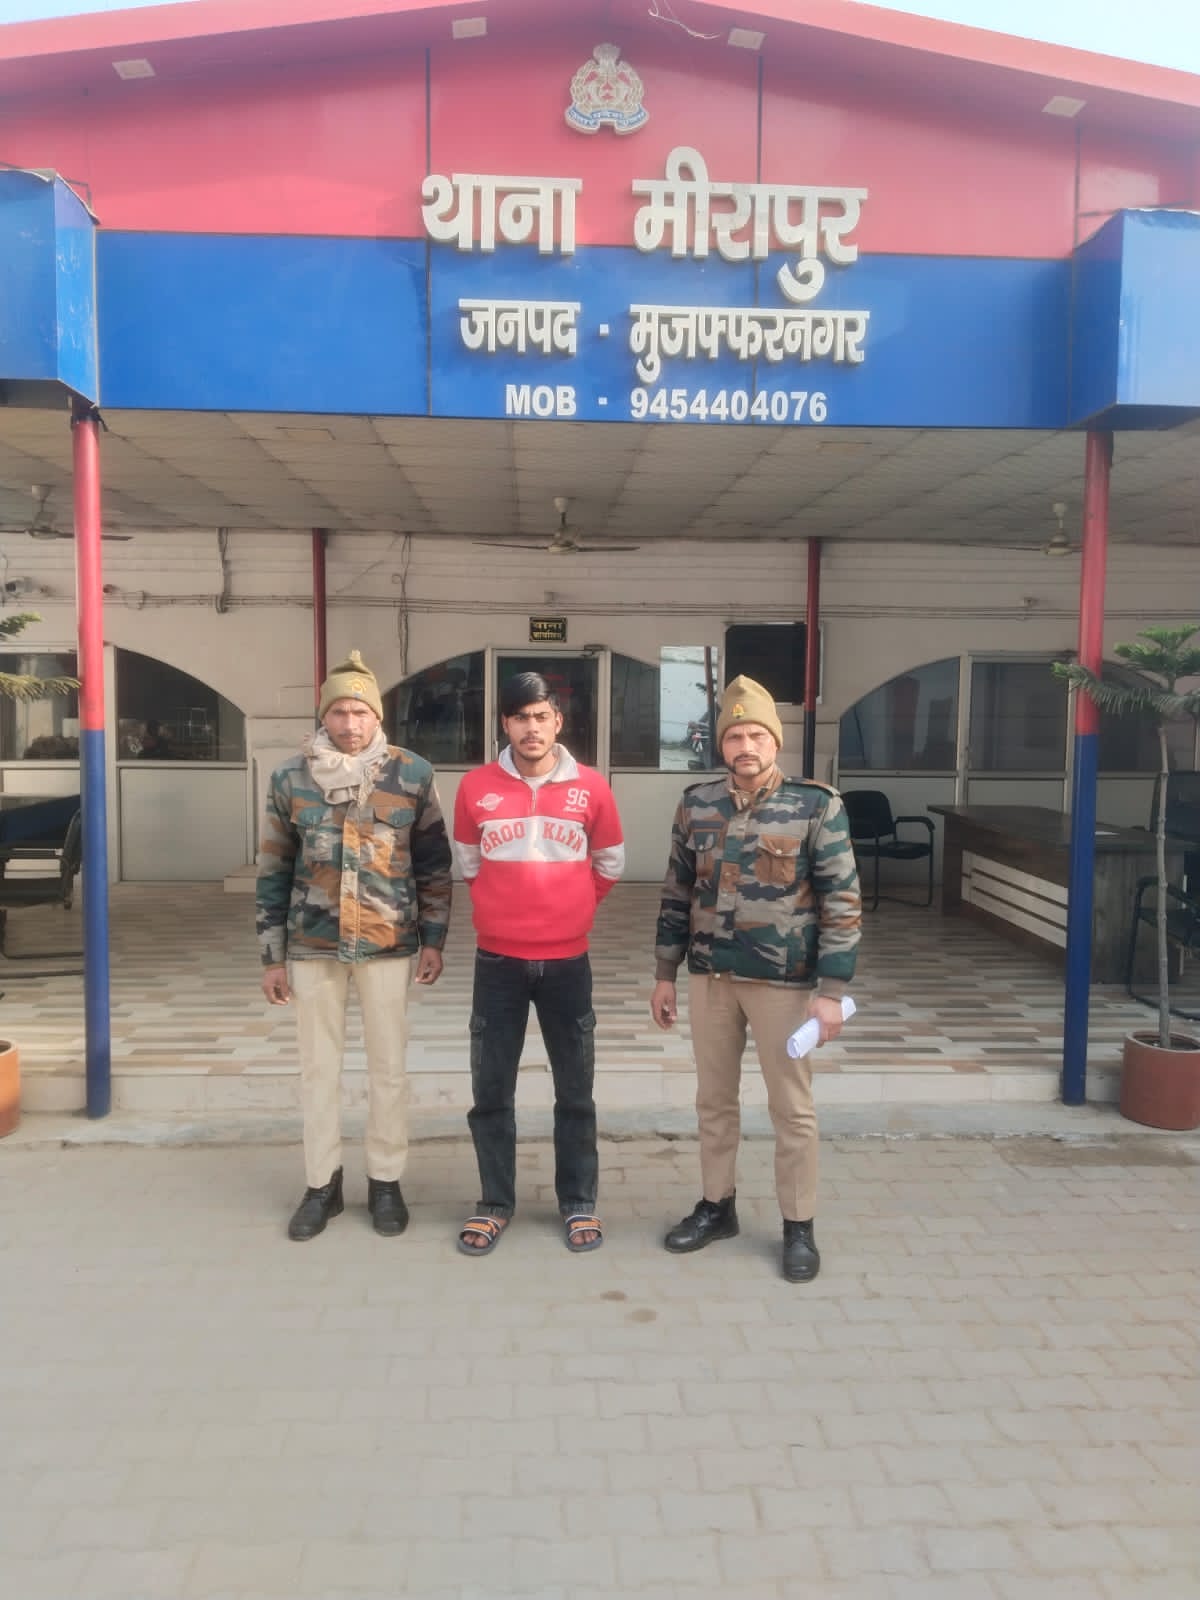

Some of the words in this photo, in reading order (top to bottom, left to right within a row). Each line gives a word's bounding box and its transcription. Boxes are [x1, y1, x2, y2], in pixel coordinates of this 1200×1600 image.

[422, 173, 582, 255] थाना
[631, 146, 868, 302] मीरापुर
[458, 298, 581, 354] जनपद
[630, 304, 870, 383] मुजफ्फरनगर
[505, 384, 577, 416] MOB
[631, 387, 827, 422] 9454404076
[566, 787, 590, 808] 96
